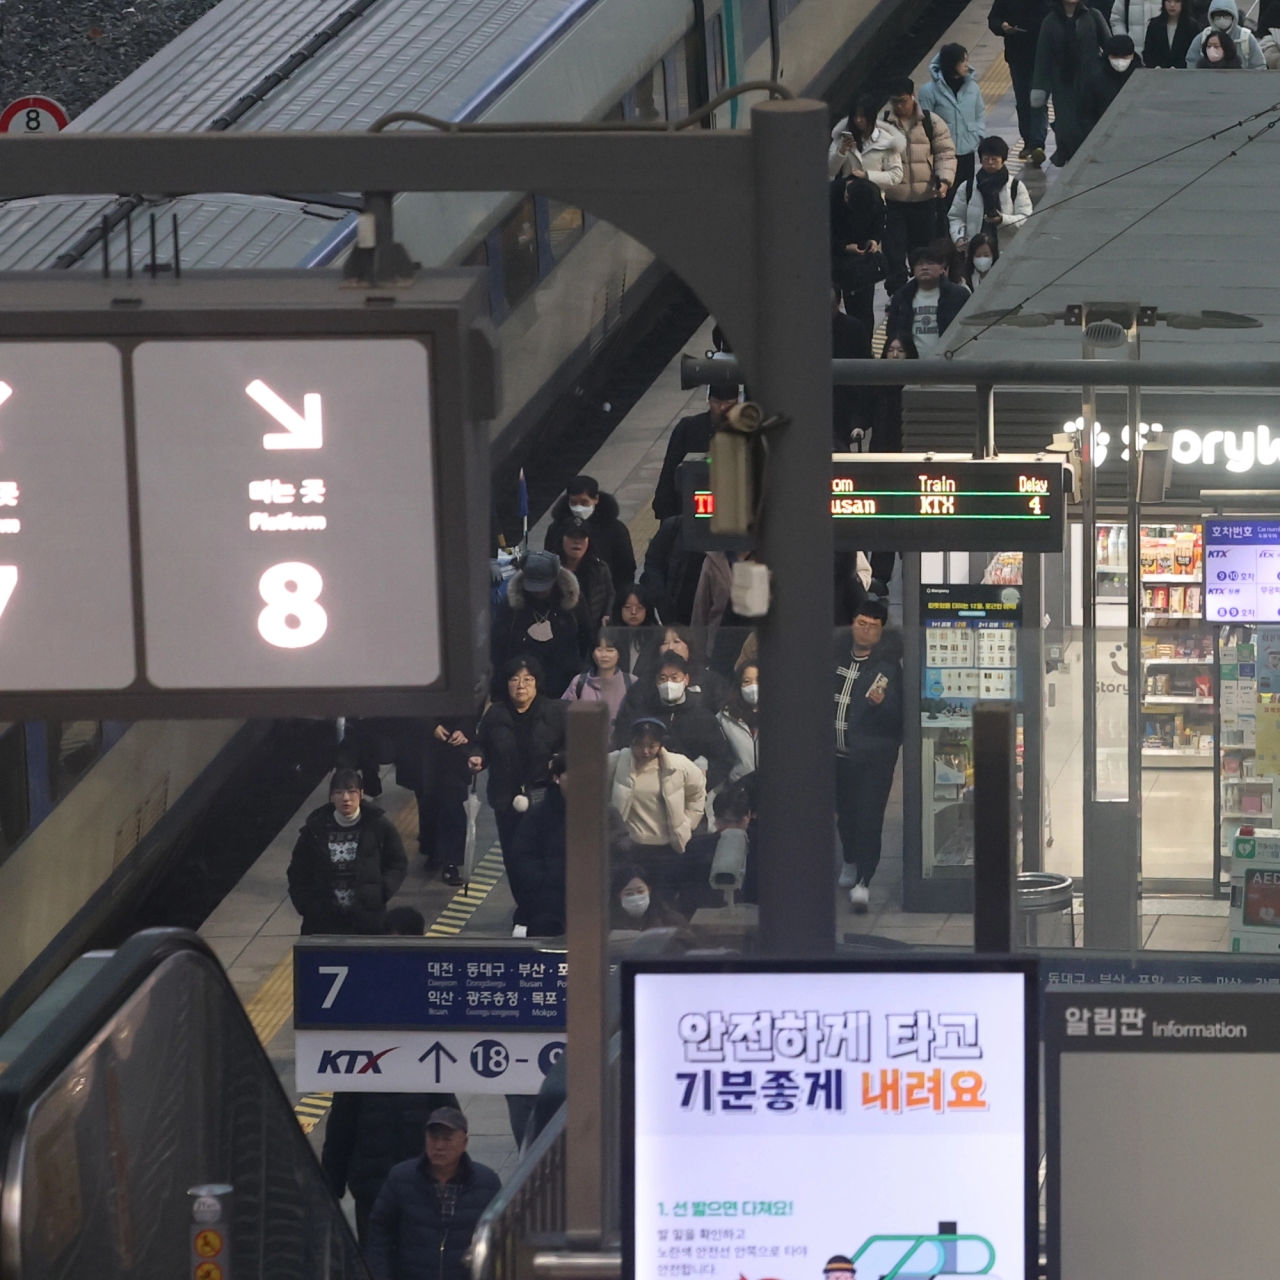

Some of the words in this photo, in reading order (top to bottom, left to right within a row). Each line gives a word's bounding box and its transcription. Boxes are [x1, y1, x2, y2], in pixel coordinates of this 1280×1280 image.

[26, 109, 40, 131] 8
[300, 479, 326, 503] 곳
[919, 475, 956, 493] Train
[1019, 475, 1048, 495] Delay
[832, 498, 876, 514] usan
[920, 498, 955, 514] KTX
[1029, 498, 1041, 514] 4
[249, 512, 327, 531] Platform
[1212, 526, 1253, 538] 호차번호
[1208, 549, 1231, 558] KTX
[1241, 573, 1254, 581] 호차
[258, 562, 328, 648] 8
[1241, 609, 1255, 617] 호차
[428, 962, 453, 977] 대전
[466, 962, 505, 977] 동대구
[518, 962, 544, 978] 부산
[318, 966, 349, 1009] 7
[519, 980, 542, 988] Busan
[428, 990, 453, 1006] 익산
[466, 990, 518, 1006] 광주송정
[532, 991, 557, 1006] 목포
[532, 1009, 557, 1018] Mokpo
[1065, 1007, 1146, 1036] 알림판
[1152, 1020, 1247, 1038] Information
[677, 1010, 871, 1063] 안전하게
[885, 1010, 984, 1063] 타고
[317, 1046, 402, 1074] KTX
[472, 1046, 508, 1072] 18
[674, 1068, 844, 1112] 기분좋게
[861, 1068, 989, 1112] 내려요
[658, 1202, 668, 1216] 1.
[673, 1201, 688, 1217] 선
[742, 1201, 793, 1216] 다쳐요!
[700, 1229, 745, 1241] 확인하고
[658, 1246, 692, 1259] 노란색
[695, 1246, 731, 1259] 안전선
[734, 1246, 779, 1258] 안쪽으로
